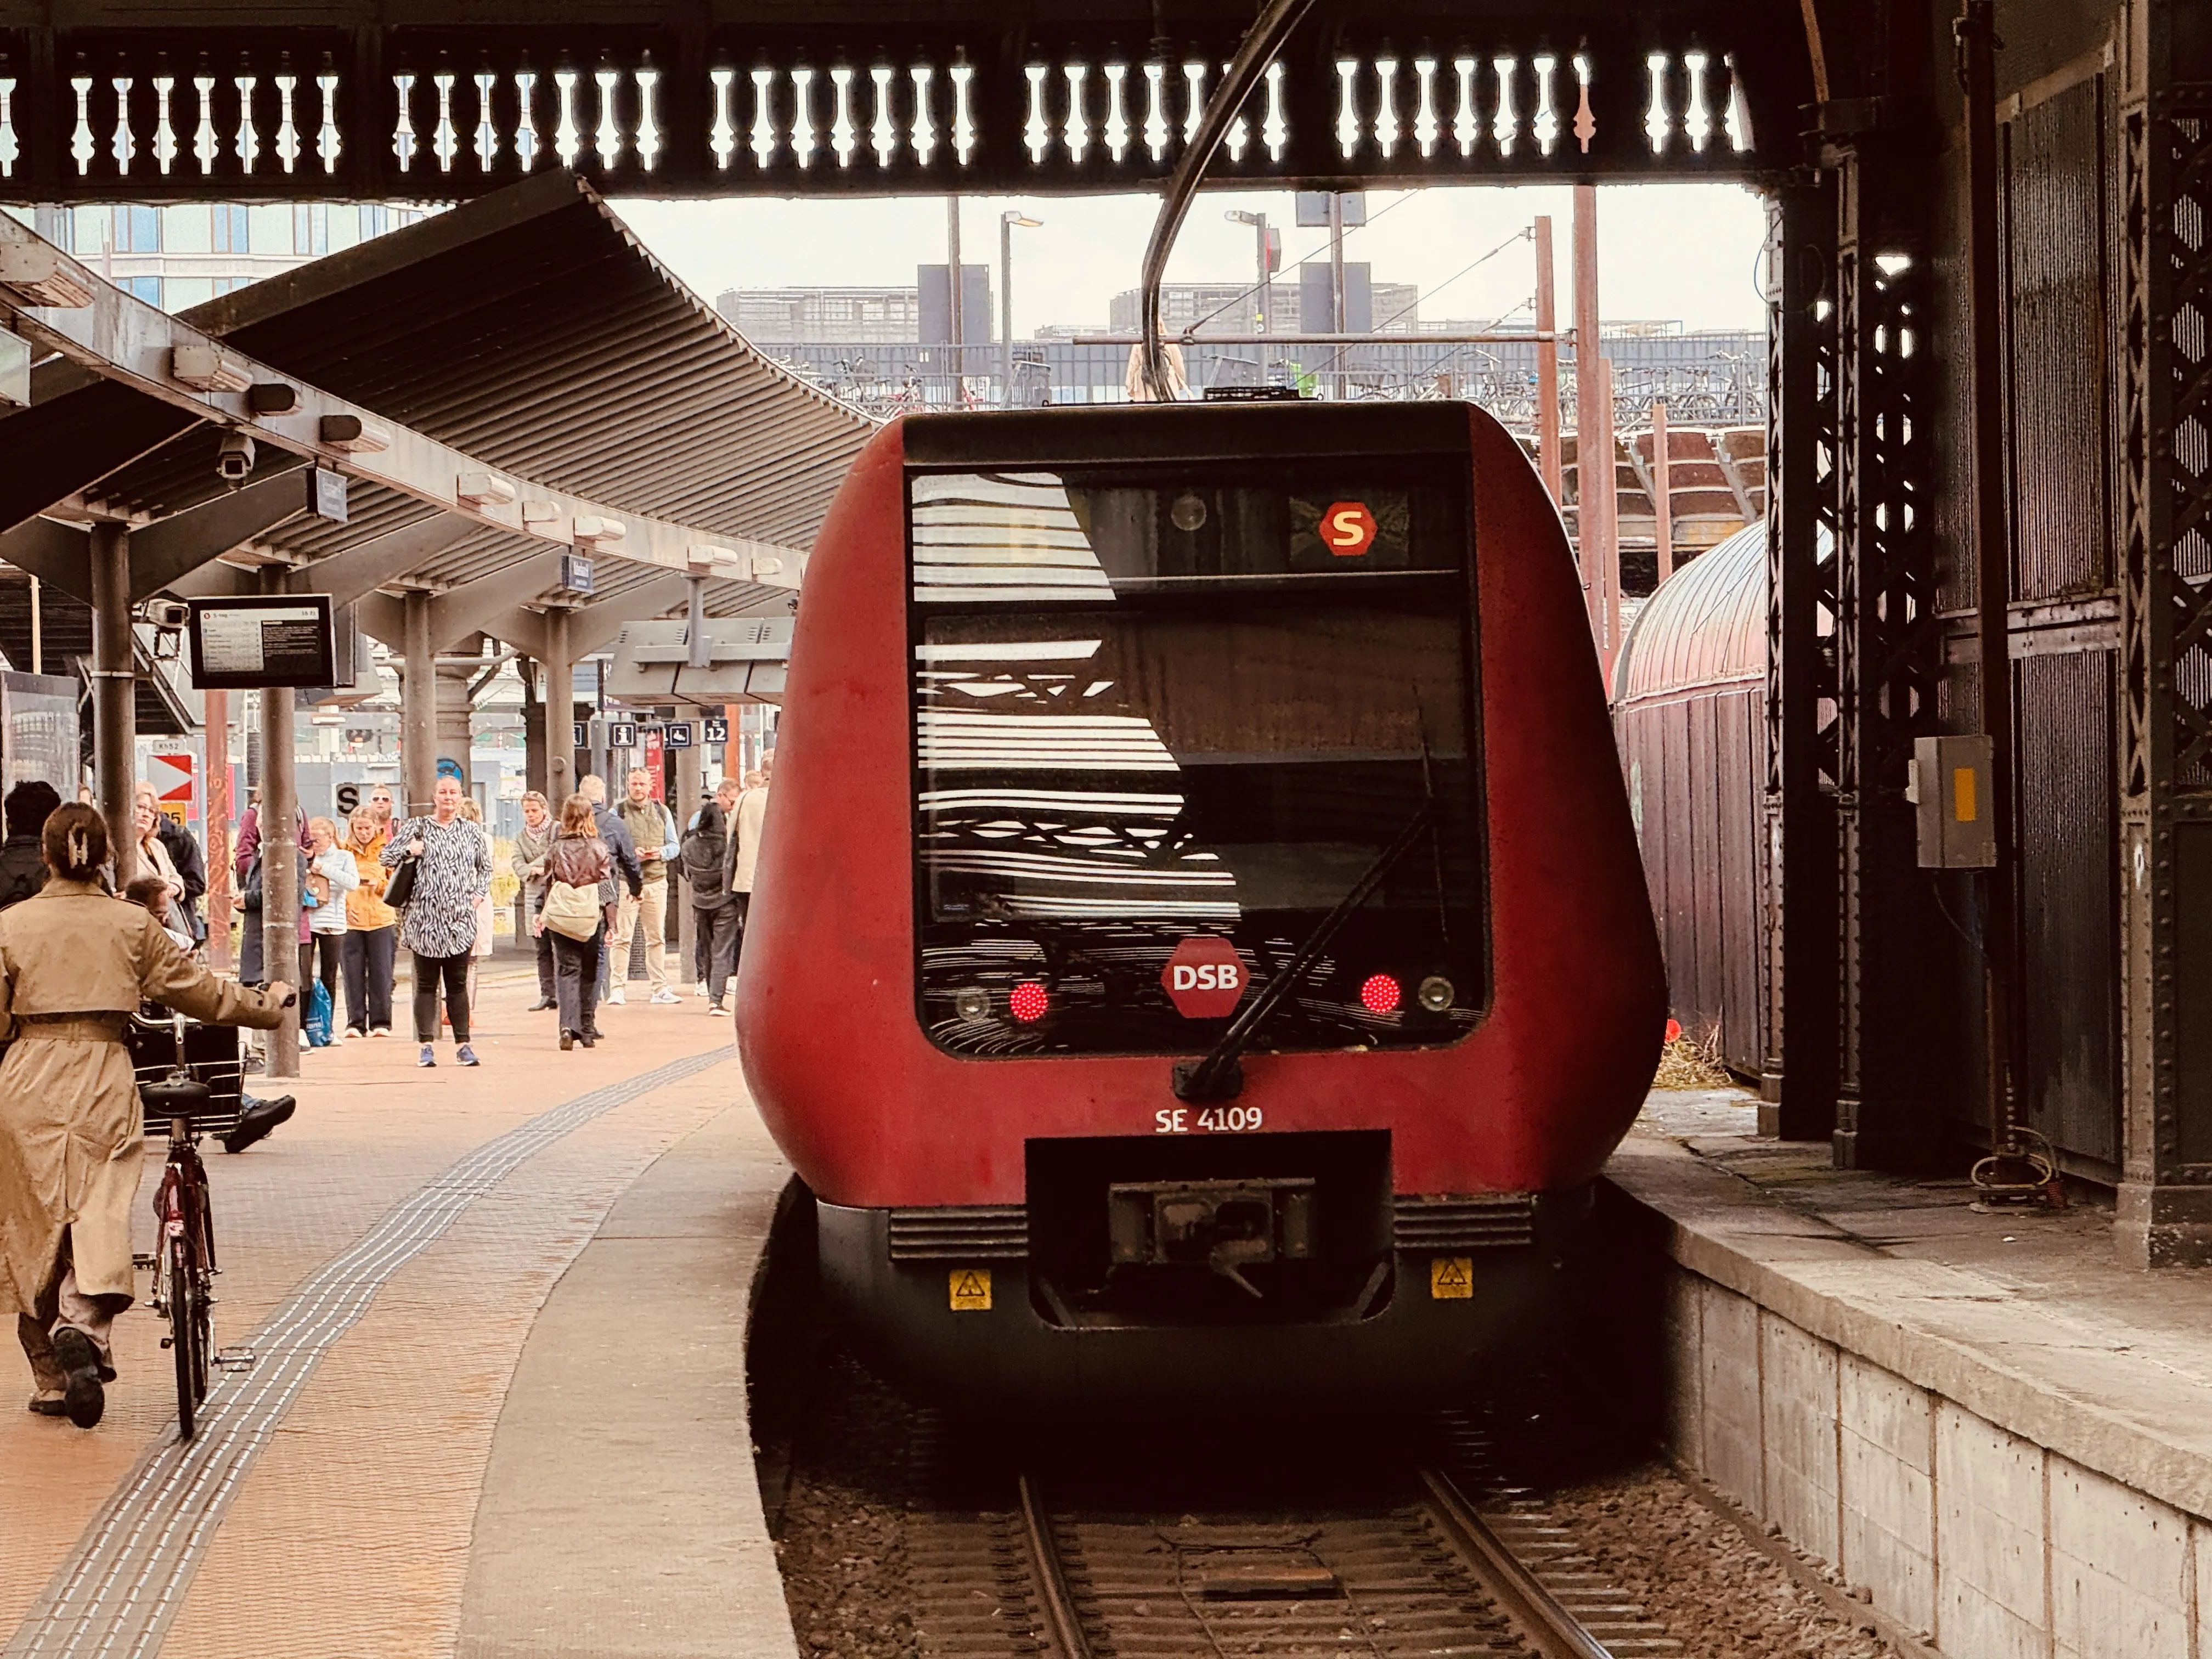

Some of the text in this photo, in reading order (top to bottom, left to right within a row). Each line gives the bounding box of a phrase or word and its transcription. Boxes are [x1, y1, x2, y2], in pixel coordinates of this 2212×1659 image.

[1333, 511, 1364, 546] S
[707, 727, 726, 741] 12
[338, 787, 358, 814] S
[1173, 964, 1238, 990] DSB
[1155, 1107, 1262, 1132] SE 4109
